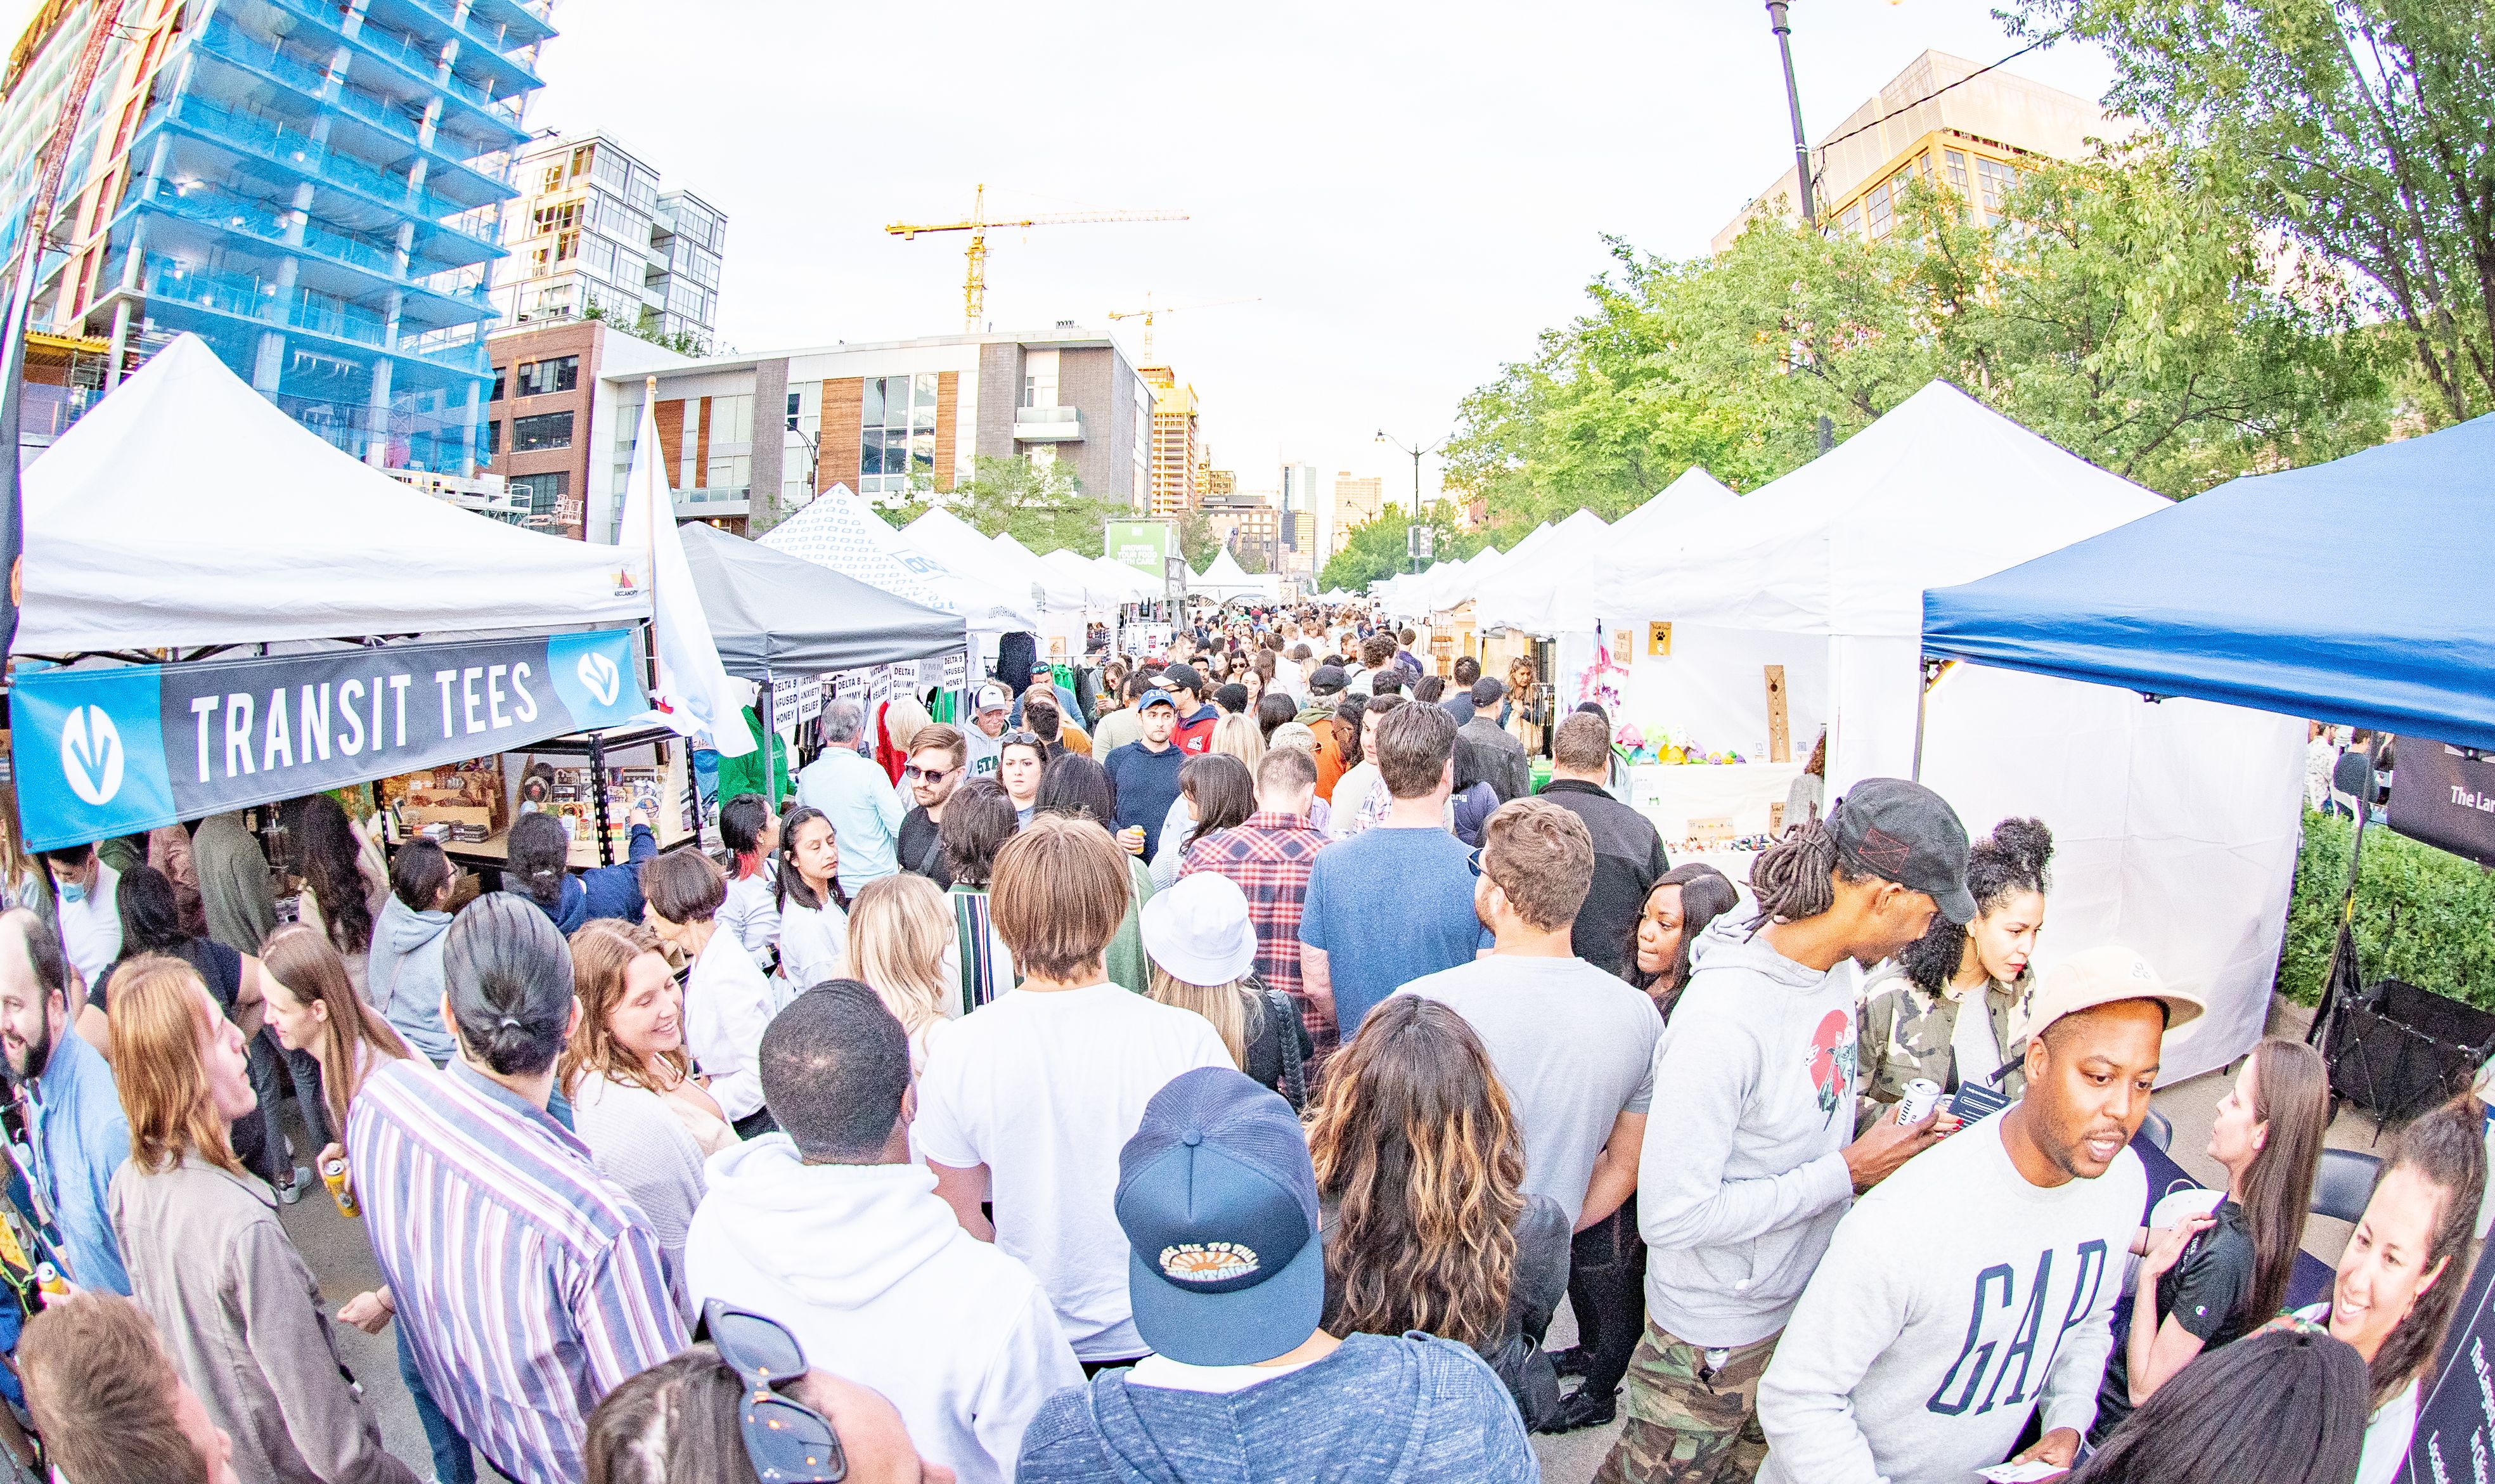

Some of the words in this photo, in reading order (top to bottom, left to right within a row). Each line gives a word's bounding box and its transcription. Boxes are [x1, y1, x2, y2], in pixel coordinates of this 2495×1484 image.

[944, 656, 958, 664] DELTA
[894, 667, 911, 676] DELTA
[943, 666, 964, 676] INFUSED
[775, 680, 792, 693] DELTA
[793, 679, 797, 688] 9
[838, 678, 856, 690] DELTA
[893, 680, 915, 688] GUMMY
[946, 678, 963, 687] HONEY
[800, 687, 820, 700] ANXIETY
[873, 685, 887, 701] RELIEF
[774, 694, 797, 709] INFUSED
[802, 700, 818, 714] RELIEF
[191, 674, 411, 783] TRANSIT
[435, 662, 539, 739] TEES
[776, 709, 795, 725] HONEY
[2451, 785, 2475, 808] The
[1207, 1242, 1232, 1253] TO
[1926, 1238, 2108, 1417] GAP
[2470, 1336, 2484, 1375] The
